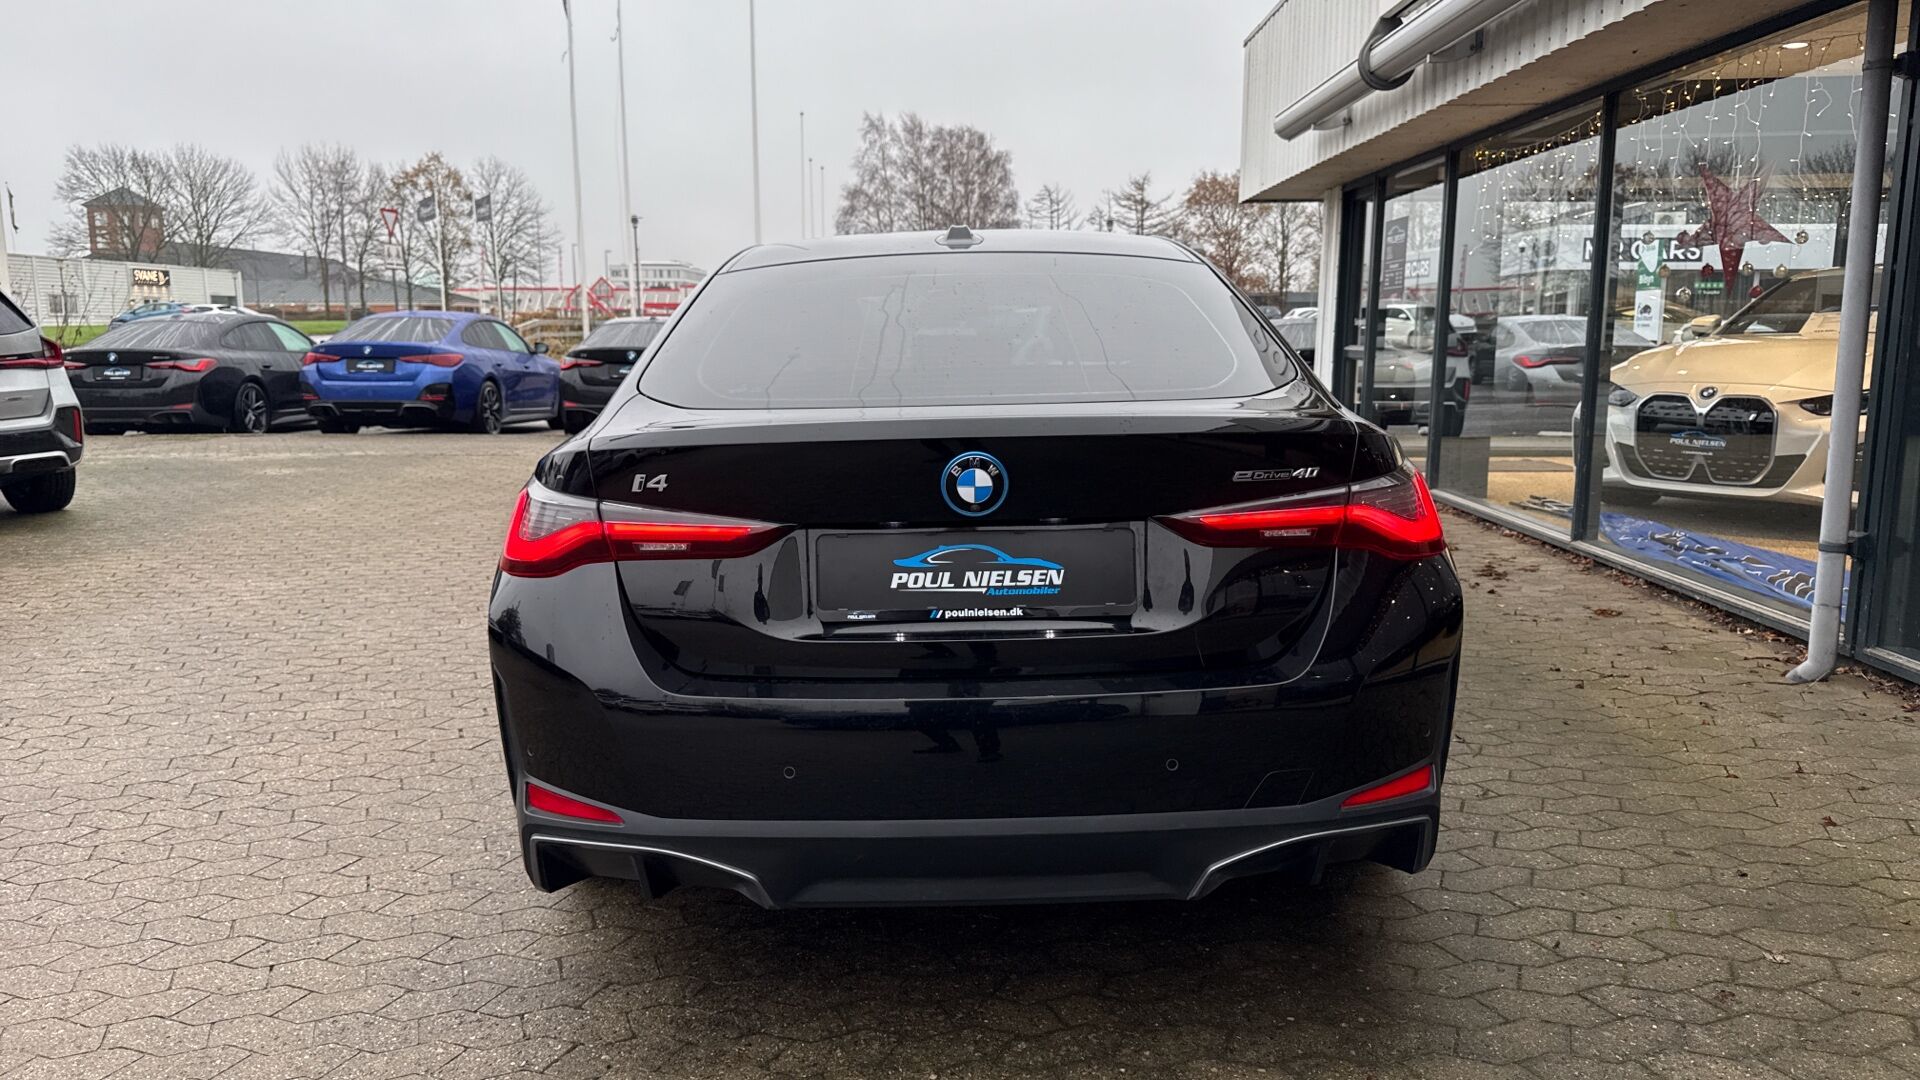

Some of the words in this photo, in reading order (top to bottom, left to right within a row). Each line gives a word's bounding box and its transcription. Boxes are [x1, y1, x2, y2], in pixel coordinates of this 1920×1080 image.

[950, 457, 1000, 478] BMW
[631, 473, 669, 493] i4
[890, 571, 955, 589] POUL
[962, 569, 1064, 587] NIELSEN
[986, 587, 1061, 596] Automobiler
[944, 606, 1024, 619] poulnielsen.dk
